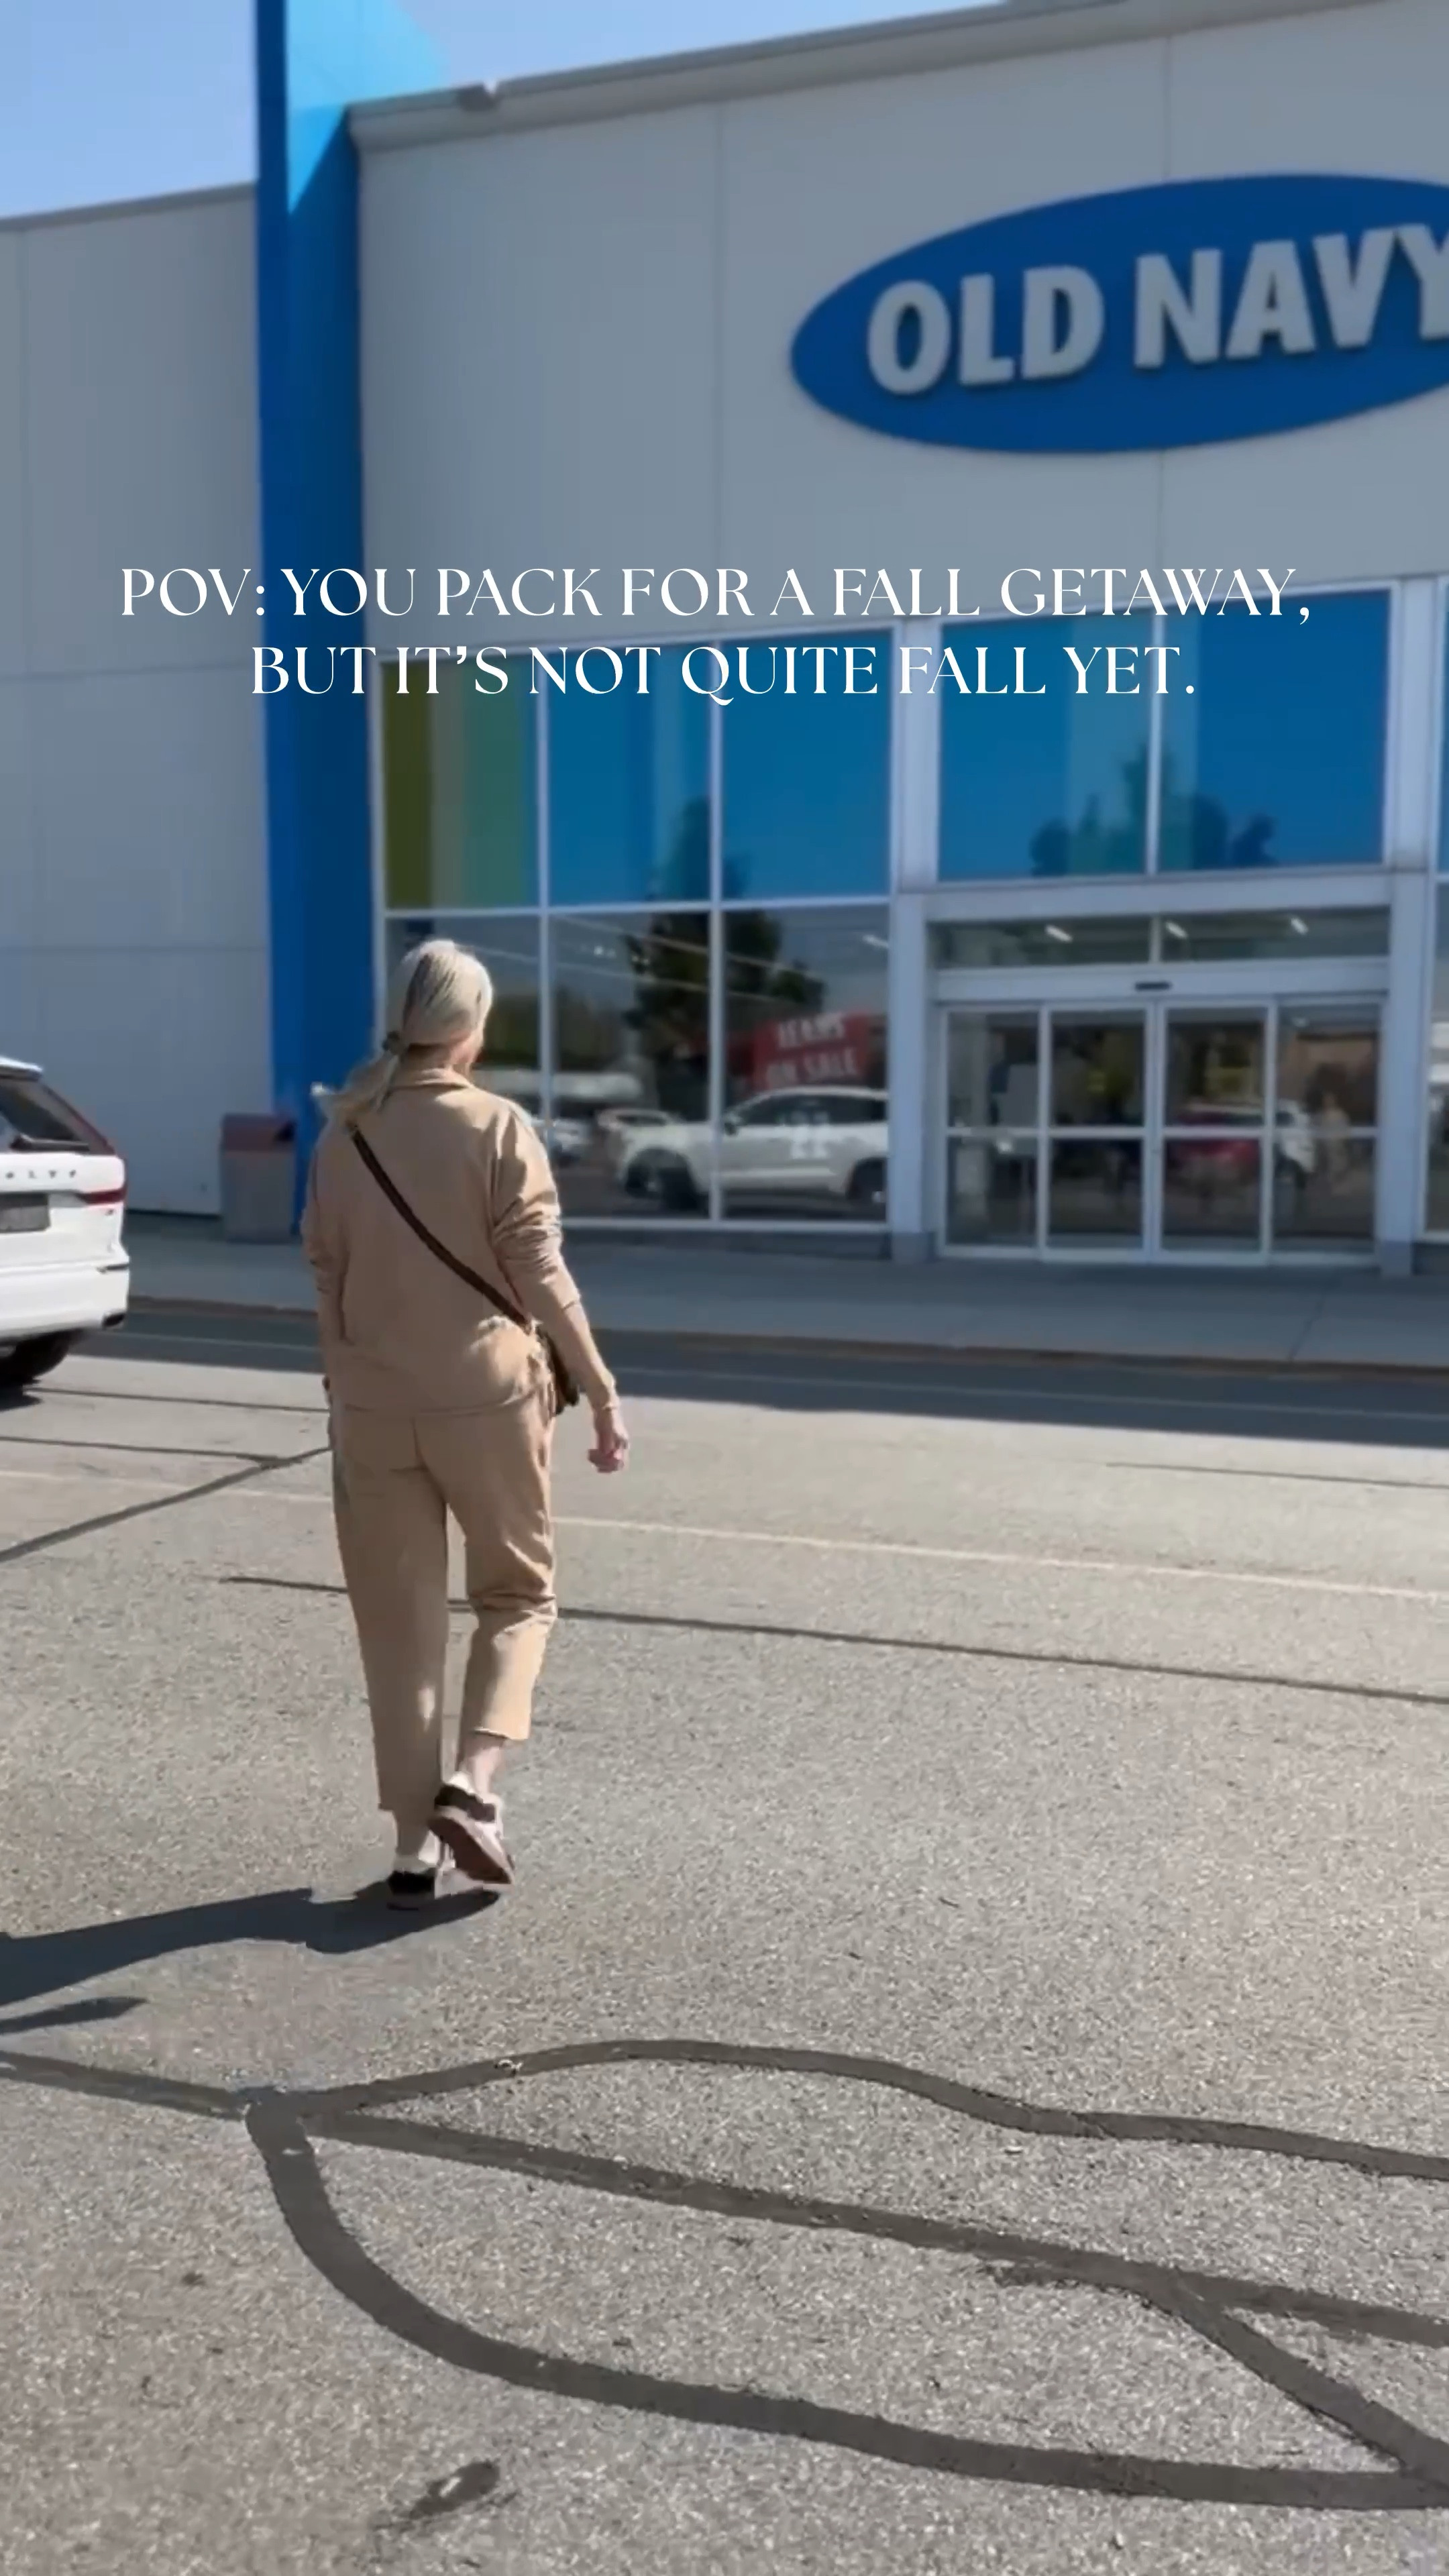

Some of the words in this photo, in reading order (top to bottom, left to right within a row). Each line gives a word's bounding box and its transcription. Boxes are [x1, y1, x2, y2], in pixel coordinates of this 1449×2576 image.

[867, 265, 1105, 395] OLD
[1134, 223, 1449, 370] NAVY
[804, 1046, 858, 1083] SALE
